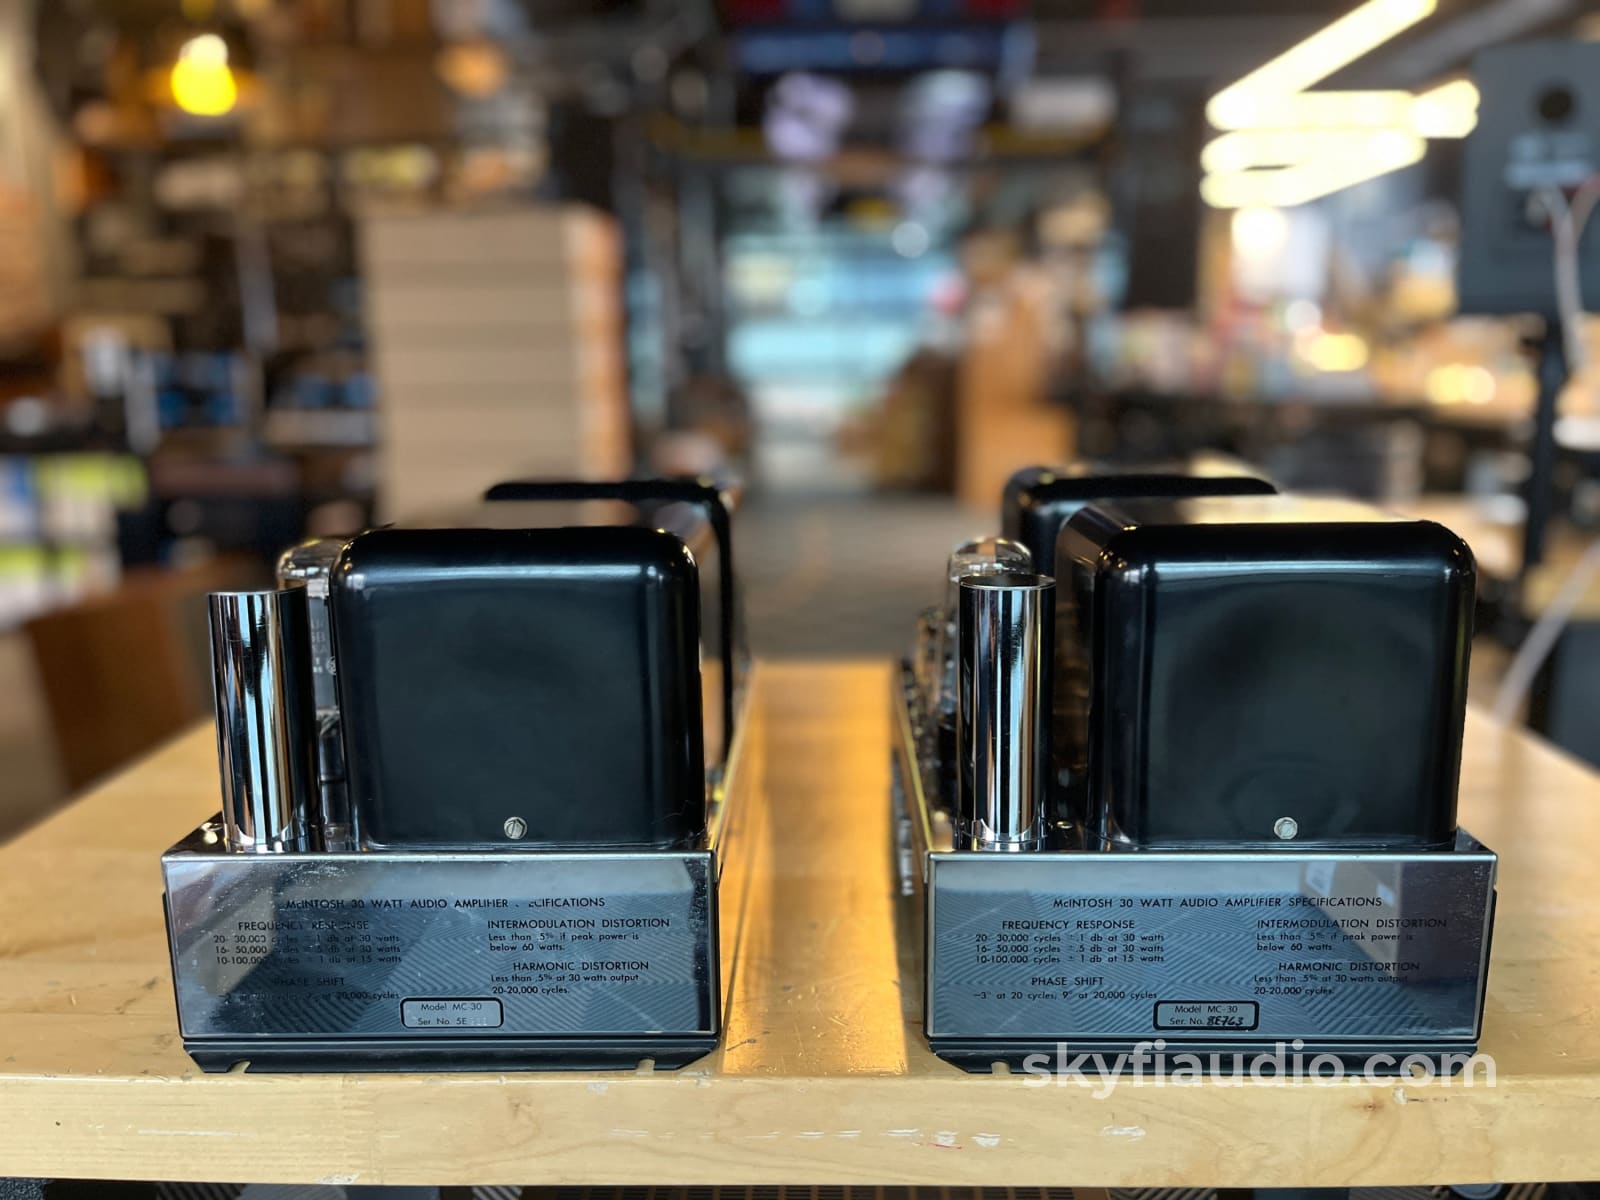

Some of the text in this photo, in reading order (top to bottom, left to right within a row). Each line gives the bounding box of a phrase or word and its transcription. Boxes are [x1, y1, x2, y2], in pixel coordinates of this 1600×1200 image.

[286, 899, 345, 908] McINTOSH
[351, 899, 365, 908] 30
[371, 899, 403, 908] WATT
[410, 899, 448, 908] AUDIO
[1053, 898, 1382, 908] McINTOSH 30 WATT AUDIO AMPLIFIER SPECIFICATIONS
[238, 921, 304, 930] FREQUENCY
[488, 918, 670, 929] INTERMODULATION DISTORTION
[1002, 920, 1136, 930] FREQUENCY RESPONSE
[1257, 918, 1448, 928] INTERMODULATION DISTORTION
[360, 934, 372, 942] 30
[488, 933, 506, 941] Less
[511, 932, 532, 941] than
[560, 932, 566, 940] if
[571, 932, 594, 942] peak
[598, 932, 628, 942] power
[632, 932, 640, 940] is
[996, 934, 1030, 943] 30,000
[1033, 934, 1061, 943] cycles
[1090, 933, 1103, 942] db
[1108, 934, 1118, 942] at
[1122, 933, 1136, 942] 30
[1140, 934, 1165, 942] watts
[1256, 933, 1275, 941] Less
[1280, 932, 1302, 941] than
[1330, 932, 1338, 940] if
[1342, 932, 1366, 942] peak
[1370, 933, 1400, 942] power
[235, 946, 268, 955] 50,000
[360, 945, 372, 953] 30
[490, 943, 518, 952] below
[522, 943, 534, 951] 60
[996, 944, 1029, 954] 50,000
[1034, 944, 1061, 954] cycles
[1090, 944, 1102, 953] db
[1108, 944, 1117, 952] at
[1122, 944, 1135, 952] 30
[1256, 942, 1285, 952] below
[1290, 943, 1303, 951] 60
[361, 954, 372, 963] 15
[378, 955, 402, 963] watts
[976, 954, 1029, 964] 10-100,000
[1033, 954, 1061, 965] cycles
[1090, 954, 1102, 964] db
[1108, 955, 1118, 963] at
[1123, 954, 1134, 963] 15
[1140, 955, 1165, 963] watts
[512, 961, 650, 971] HARMONIC DISTORTION
[1278, 962, 1421, 972] HARMONIC DISTORTION
[491, 974, 509, 982] Less
[512, 974, 532, 982] than
[556, 974, 566, 982] at
[568, 974, 580, 982] 30
[582, 974, 606, 982] watts
[610, 974, 640, 983] output
[1032, 976, 1104, 986] PHASE SHIFT
[1254, 974, 1273, 983] Less
[1276, 974, 1296, 983] than
[1322, 974, 1332, 982] at
[1335, 974, 1348, 982] 30
[1350, 974, 1374, 982] watts
[1378, 974, 1408, 984] output
[492, 985, 570, 996] 20-20,000 cycles.
[1254, 986, 1302, 996] 20-20,000
[996, 992, 1006, 1000] at
[1011, 992, 1024, 1000] 20
[1078, 992, 1088, 1000] at
[1094, 991, 1126, 1000] 20,000
[1130, 992, 1158, 1002] cycles
[420, 1002, 447, 1011] Model
[1174, 1005, 1238, 1014] Model MC-30
